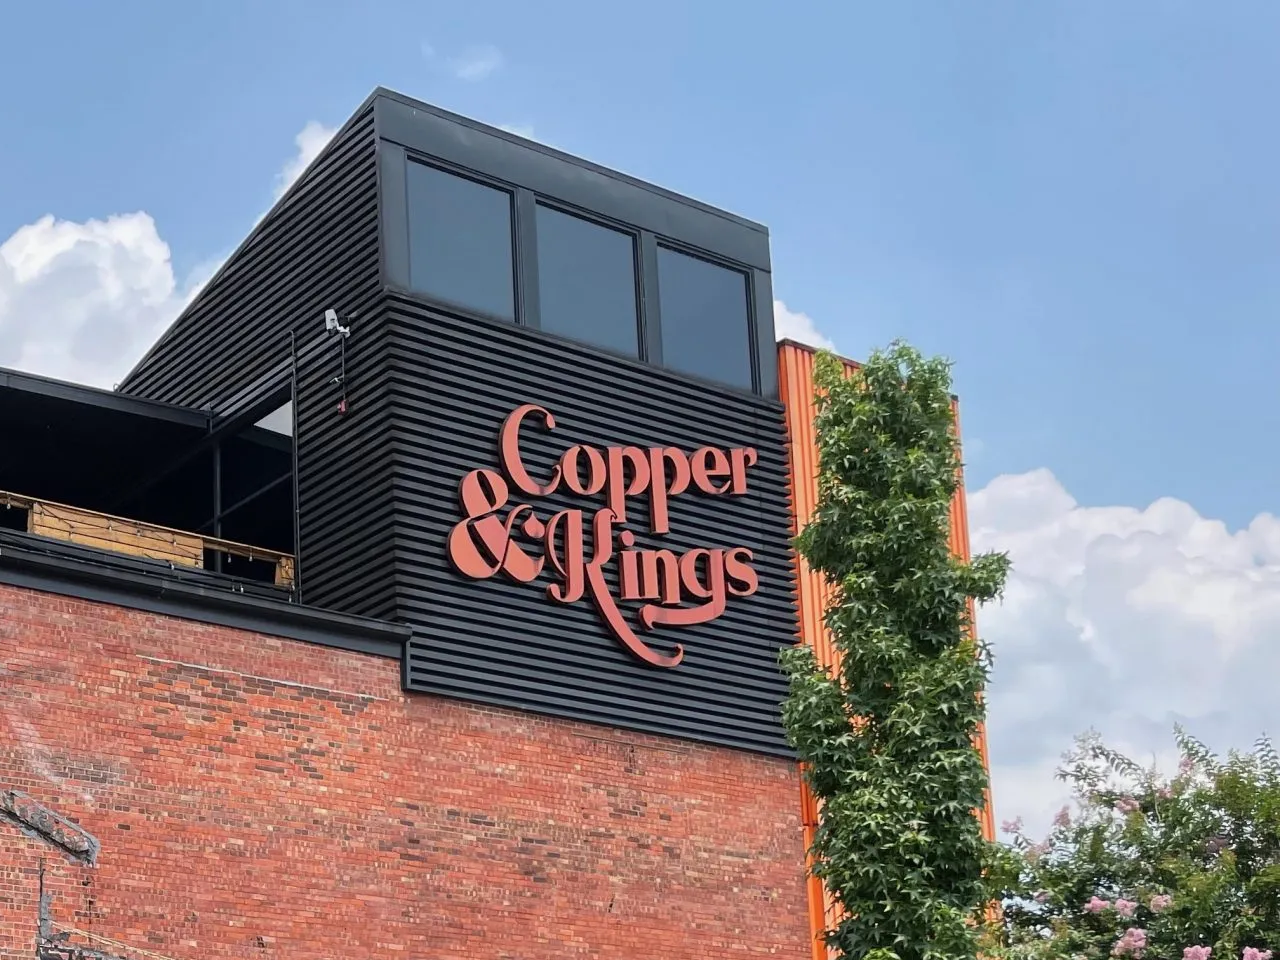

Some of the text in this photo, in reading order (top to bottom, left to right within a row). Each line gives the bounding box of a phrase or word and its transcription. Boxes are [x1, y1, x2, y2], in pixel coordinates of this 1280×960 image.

[498, 404, 758, 534] Copper
[447, 469, 759, 668] & Kings
